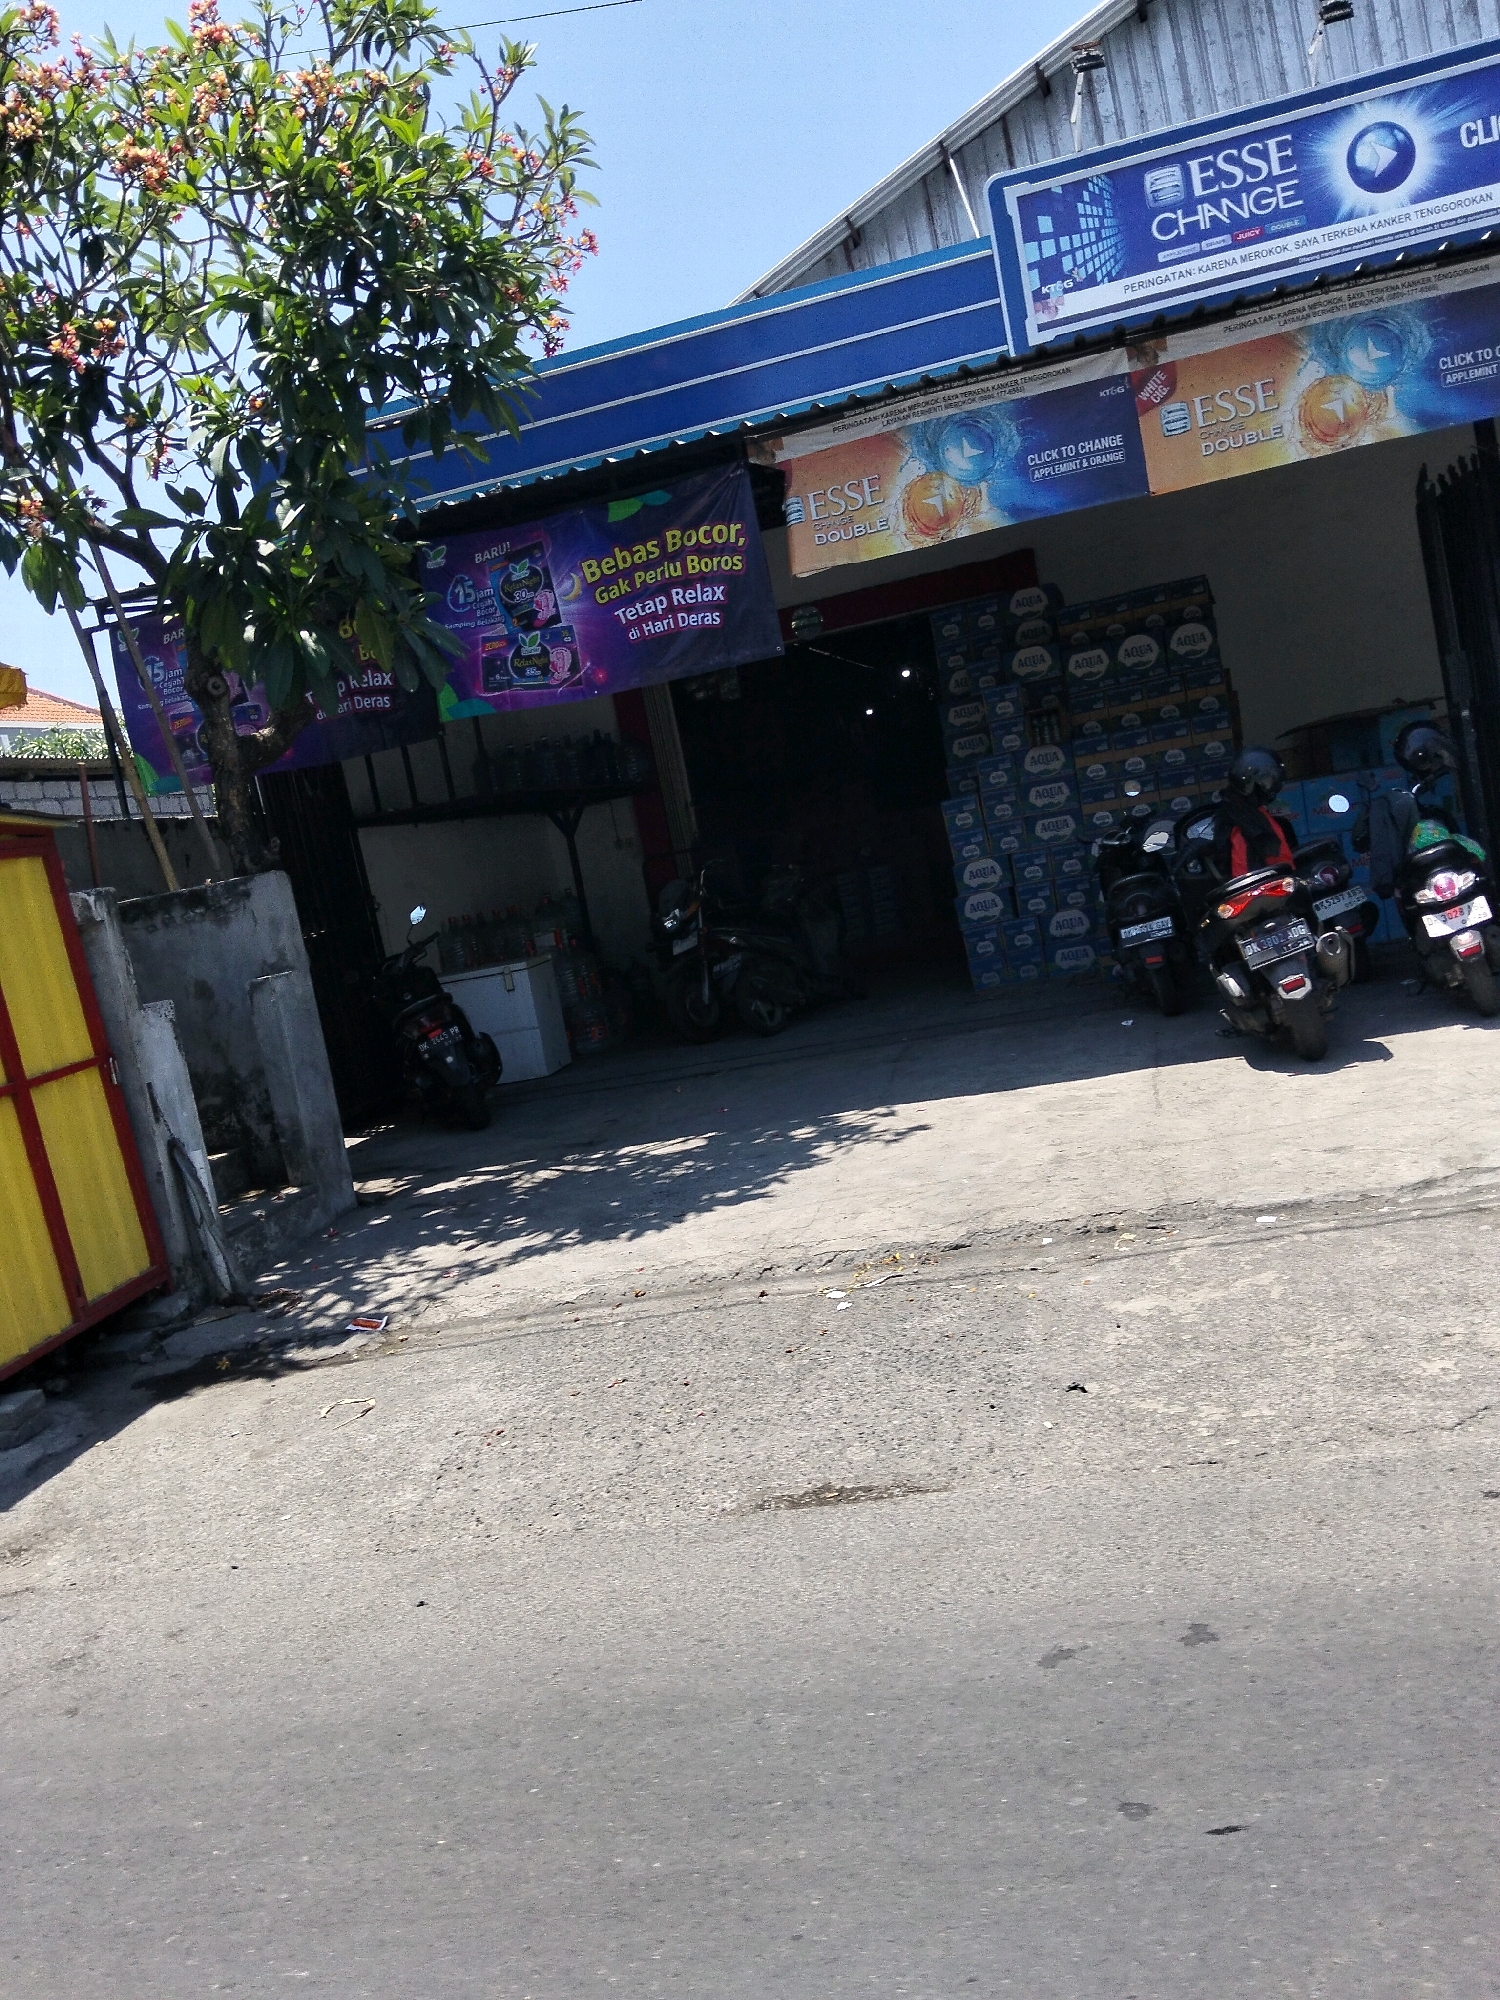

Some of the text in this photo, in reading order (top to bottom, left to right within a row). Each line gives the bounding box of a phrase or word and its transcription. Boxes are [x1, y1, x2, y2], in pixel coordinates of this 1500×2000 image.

[1460, 115, 1500, 149] CLI
[1186, 134, 1298, 197] ESSE
[1151, 179, 1304, 241] CHANGE
[1123, 191, 1494, 294] PERINGATAN: KARENA MEROKOK, SAYA TERKENA KANKER TENGGOROKAN
[1236, 228, 1261, 240] JUICY
[1041, 280, 1075, 295] KT&G
[1277, 305, 1307, 319] KARENA
[1346, 291, 1365, 302] SAYA
[1366, 284, 1399, 299] TERKENA
[1400, 277, 1432, 292] KANKER
[1433, 263, 1490, 284] TENGGOROKAN
[1349, 296, 1384, 311] MEROKOK
[1439, 351, 1475, 370] CLICK
[1475, 347, 1493, 362] TO
[1446, 363, 1499, 384] APPLEMINT
[879, 406, 907, 422] KARENA
[942, 392, 960, 404] SAYA
[960, 386, 991, 400] TERKENA
[991, 379, 1019, 394] KANKER
[1019, 367, 1072, 388] TENGGOROKAN
[1138, 370, 1168, 402] WHITE
[1150, 386, 1170, 404] CIG.
[881, 413, 912, 428] LAYANAN
[913, 406, 943, 421] BERHENTI
[944, 397, 978, 413] MEROKOK
[1192, 377, 1280, 429] ESSE
[1027, 434, 1124, 466] CLICK TO CHANGE
[1201, 425, 1283, 457] DOUBLE
[1033, 450, 1124, 480] APPLEMINT & ORANGE
[806, 474, 885, 521] ESSE
[665, 522, 746, 553] Bocor,
[814, 518, 890, 546] DOUBLE
[474, 541, 511, 564] BARU!
[581, 540, 660, 584] Bebas
[595, 554, 743, 605] Gak Perlu Boros
[454, 580, 494, 604] 15 jam
[1015, 595, 1043, 609] AQUA
[472, 599, 494, 611] Cegah
[476, 606, 498, 617] Bocor
[614, 583, 726, 625] Tetap Relax
[444, 614, 506, 630] Samping Belakang
[628, 610, 721, 641] di Hari Deras
[163, 627, 186, 645] BAR
[1175, 631, 1207, 648] AQUA
[1123, 643, 1153, 659] AQUA
[146, 661, 183, 682] 15 jam
[1017, 654, 1046, 669] AQUA
[1073, 654, 1104, 670] AQUA
[954, 679, 970, 689] AQ
[138, 699, 164, 711] Sampg
[337, 697, 353, 714] ari
[353, 695, 391, 709] Deras
[953, 704, 980, 720] AQUA
[1030, 750, 1060, 767] AQUA
[1034, 784, 1065, 801] AQUA
[1039, 818, 1070, 834] AQUA
[968, 865, 997, 880] AQUA
[969, 898, 998, 914] AQUA
[1055, 916, 1085, 931] AQUA
[1060, 947, 1090, 961] AQUA
[1244, 941, 1261, 956] DK
[418, 1041, 430, 1052] DK
[449, 1025, 460, 1036] PR
